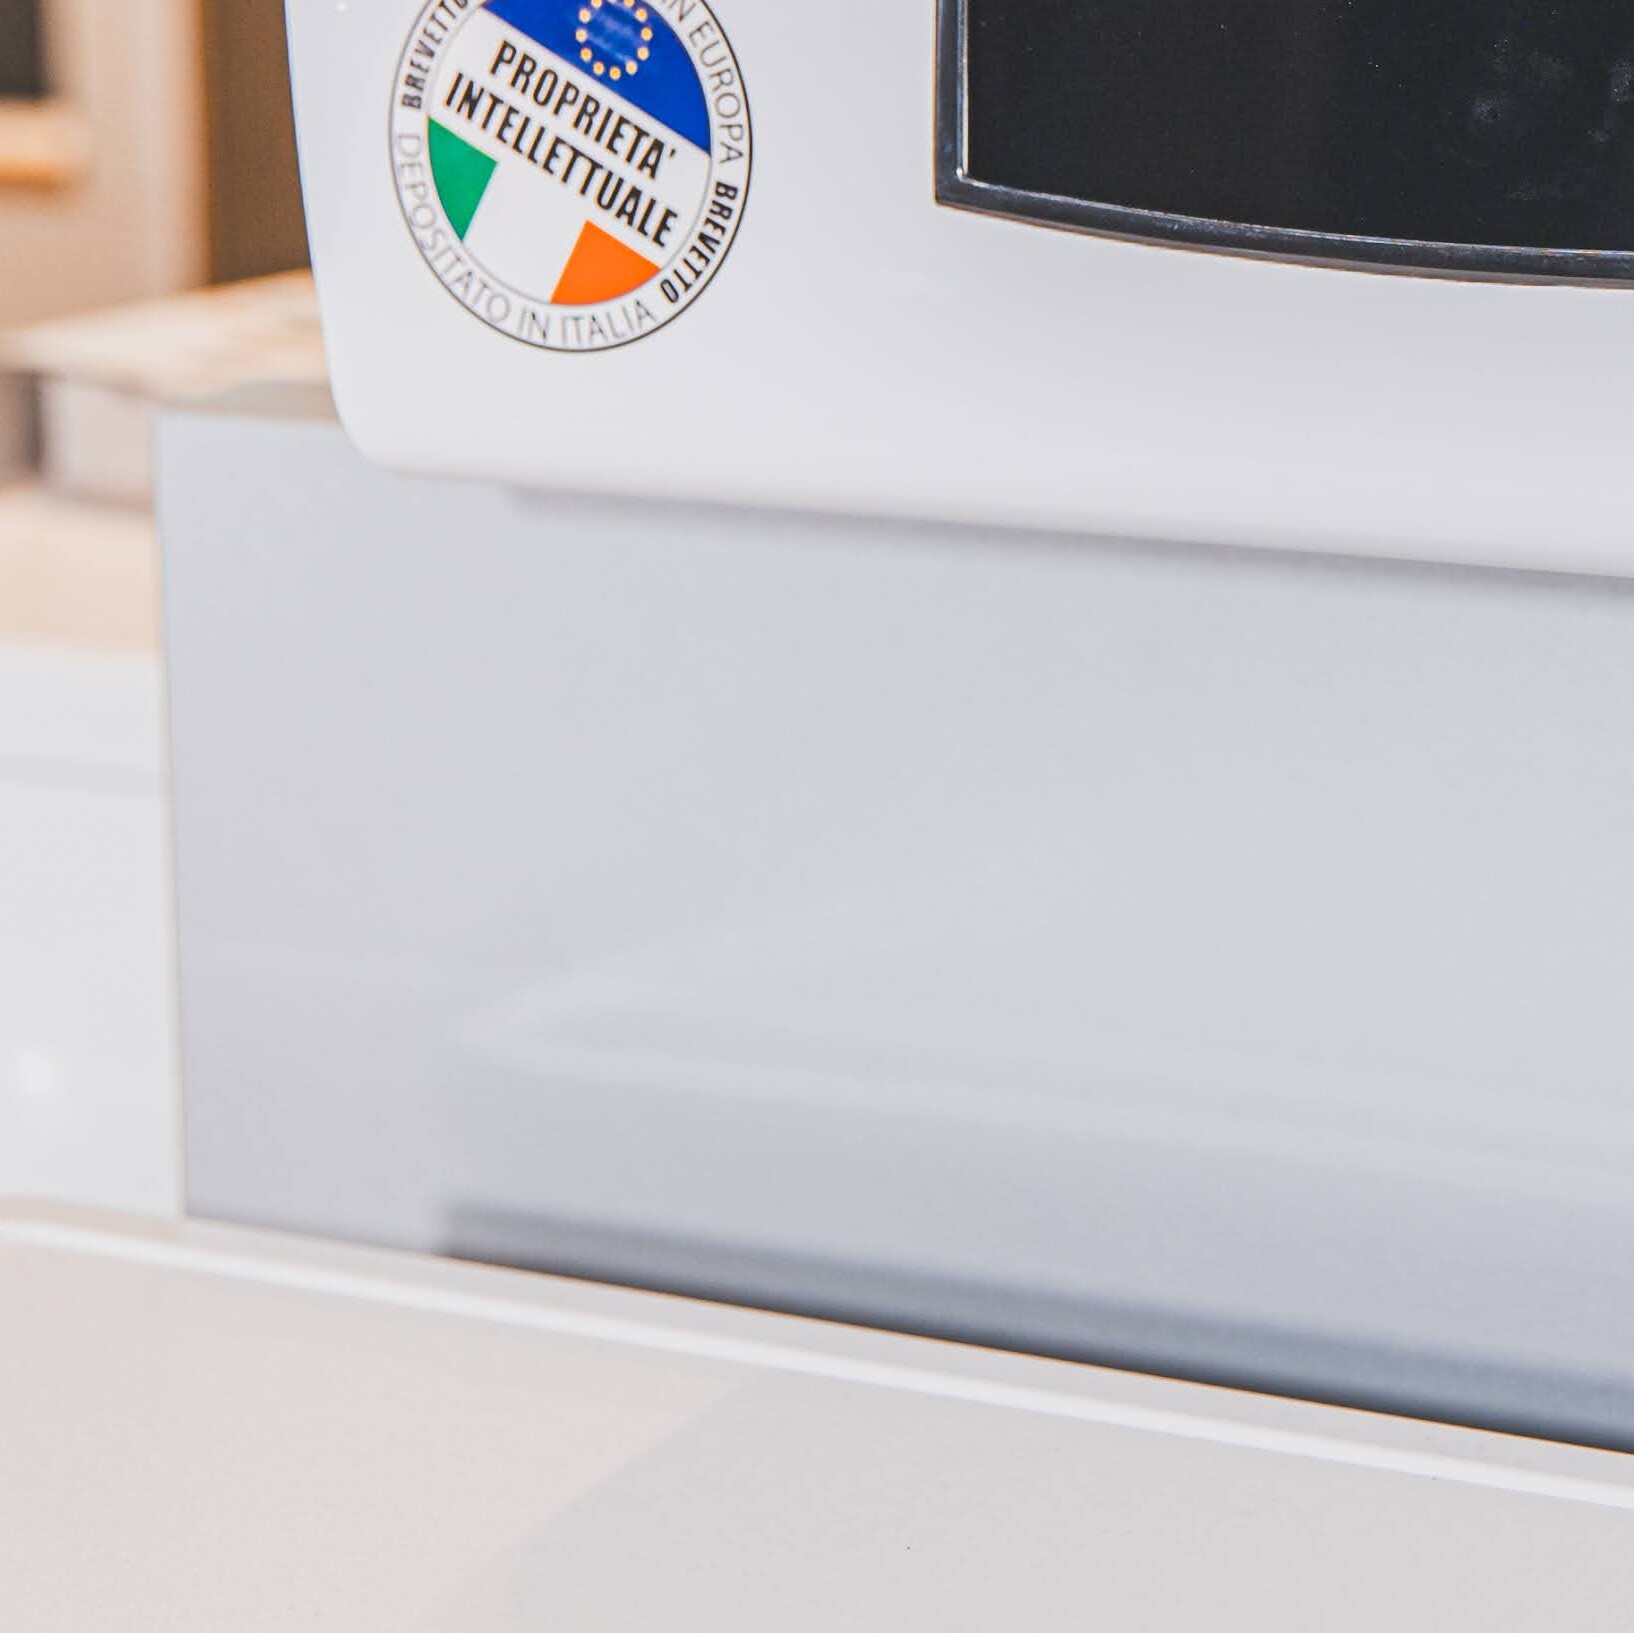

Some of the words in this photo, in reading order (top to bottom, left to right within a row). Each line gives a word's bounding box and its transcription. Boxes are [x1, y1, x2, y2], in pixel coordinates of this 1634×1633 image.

[445, 71, 678, 248] INTELLETTUALE
[687, 20, 745, 165] EUROPA
[396, 133, 512, 325] DEPOSITATO
[659, 180, 739, 304] BREVETTO
[518, 309, 552, 345] IN
[560, 299, 657, 346] ITALIA
